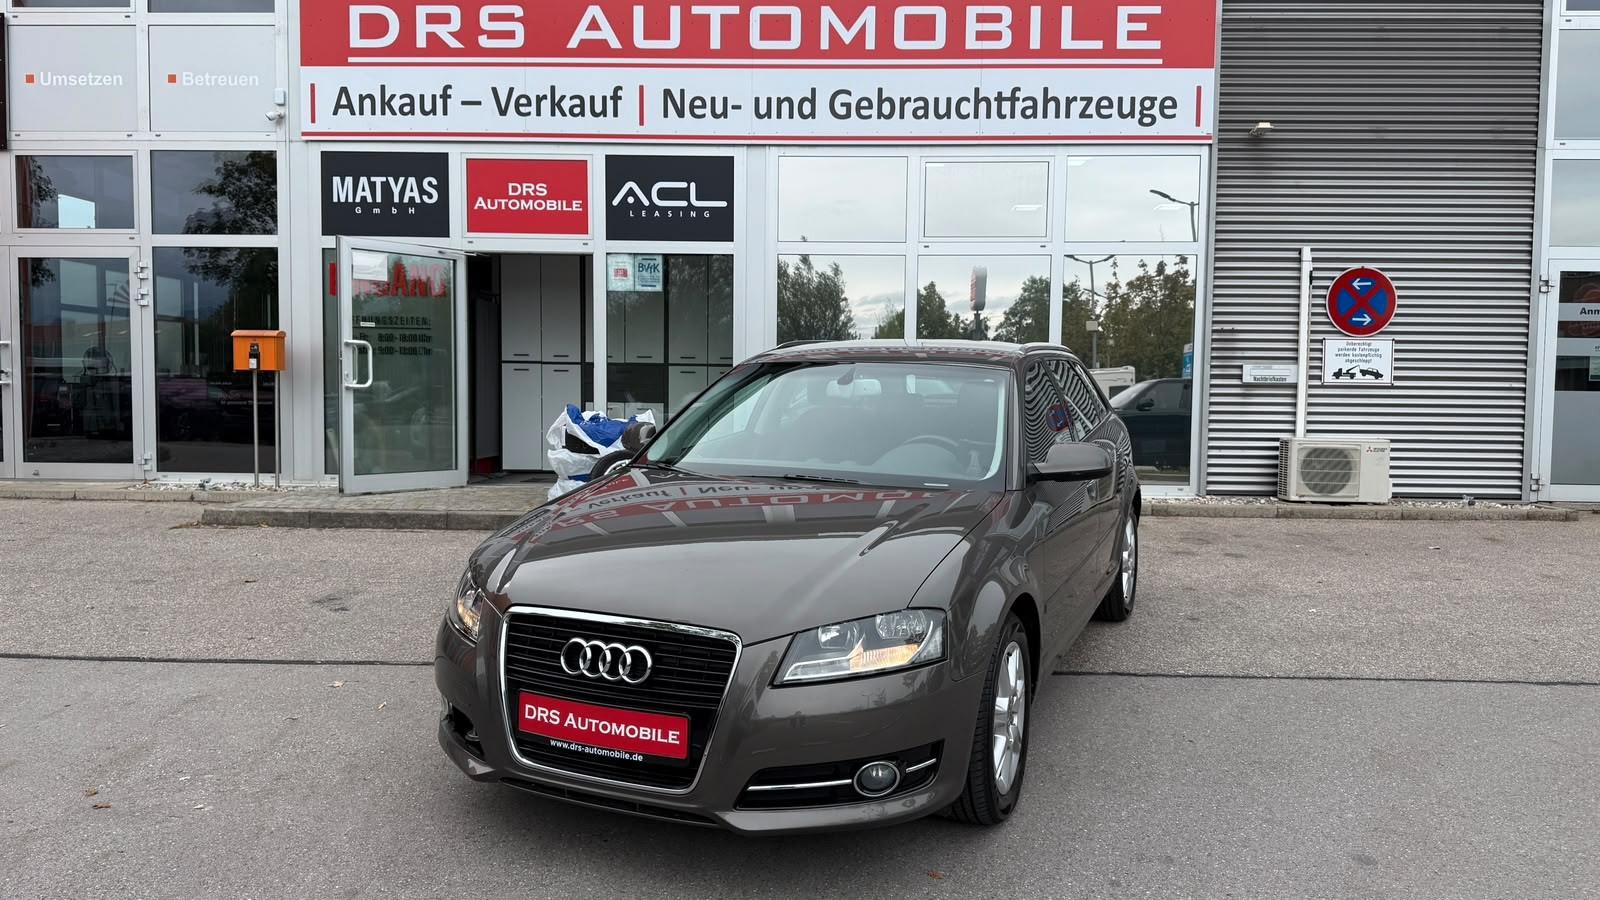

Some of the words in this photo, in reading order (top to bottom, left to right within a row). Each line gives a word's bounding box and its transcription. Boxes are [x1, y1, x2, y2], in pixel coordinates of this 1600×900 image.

[349, 5, 525, 49] DRS
[566, 5, 1162, 50] AUTOMOBILE
[40, 71, 123, 87] Umsetzen
[182, 71, 259, 87] Betreuen
[332, 84, 452, 117] Ankauf
[491, 85, 623, 118] Verkauf
[662, 88, 742, 120] Neu-
[754, 88, 817, 120] und
[829, 87, 1178, 127] Gebrauchtfahrzeuge
[332, 176, 438, 204] MATYAS
[508, 182, 548, 196] DRS
[612, 181, 728, 207] ACL
[474, 196, 583, 211] AUTOMOBILE
[525, 704, 560, 724] DRS
[564, 713, 680, 744] AUTOMOBILE
[550, 739, 643, 762] www.drs-automobile.de
